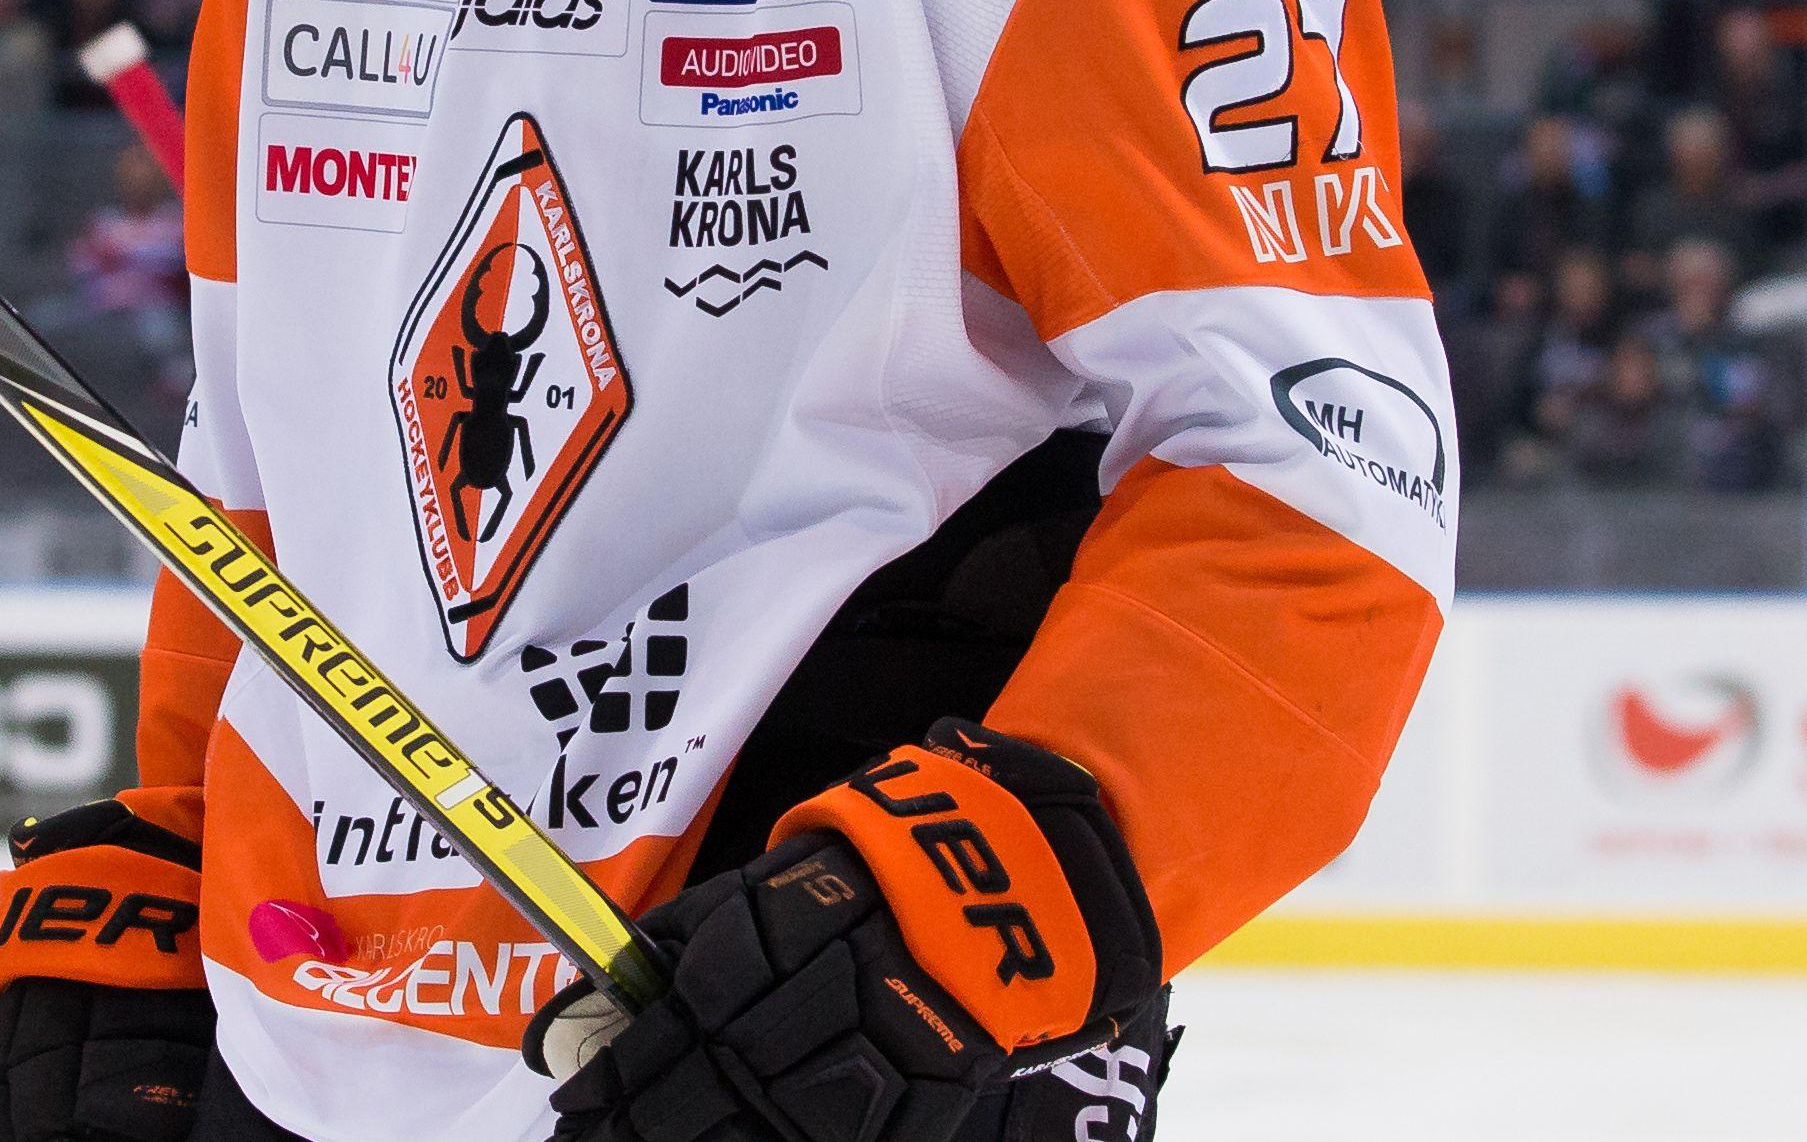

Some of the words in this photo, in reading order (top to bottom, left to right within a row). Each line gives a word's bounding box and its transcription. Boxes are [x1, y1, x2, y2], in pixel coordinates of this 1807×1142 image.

[283, 23, 437, 86] CALL4U
[700, 87, 800, 117] Panasonic
[265, 144, 418, 203] MONTE
[674, 143, 798, 198] KARLS
[668, 190, 812, 248] KRONA
[534, 179, 618, 394] KARLSKRONA
[422, 375, 449, 401] 20
[545, 384, 576, 410] 01
[1304, 399, 1365, 444] MH
[396, 376, 461, 602] HOCKEYKLUBB
[163, 514, 463, 780] SUPREME
[848, 759, 1057, 987] UER
[354, 924, 445, 961] KARLSKRO
[883, 976, 965, 1055] SUPREME
